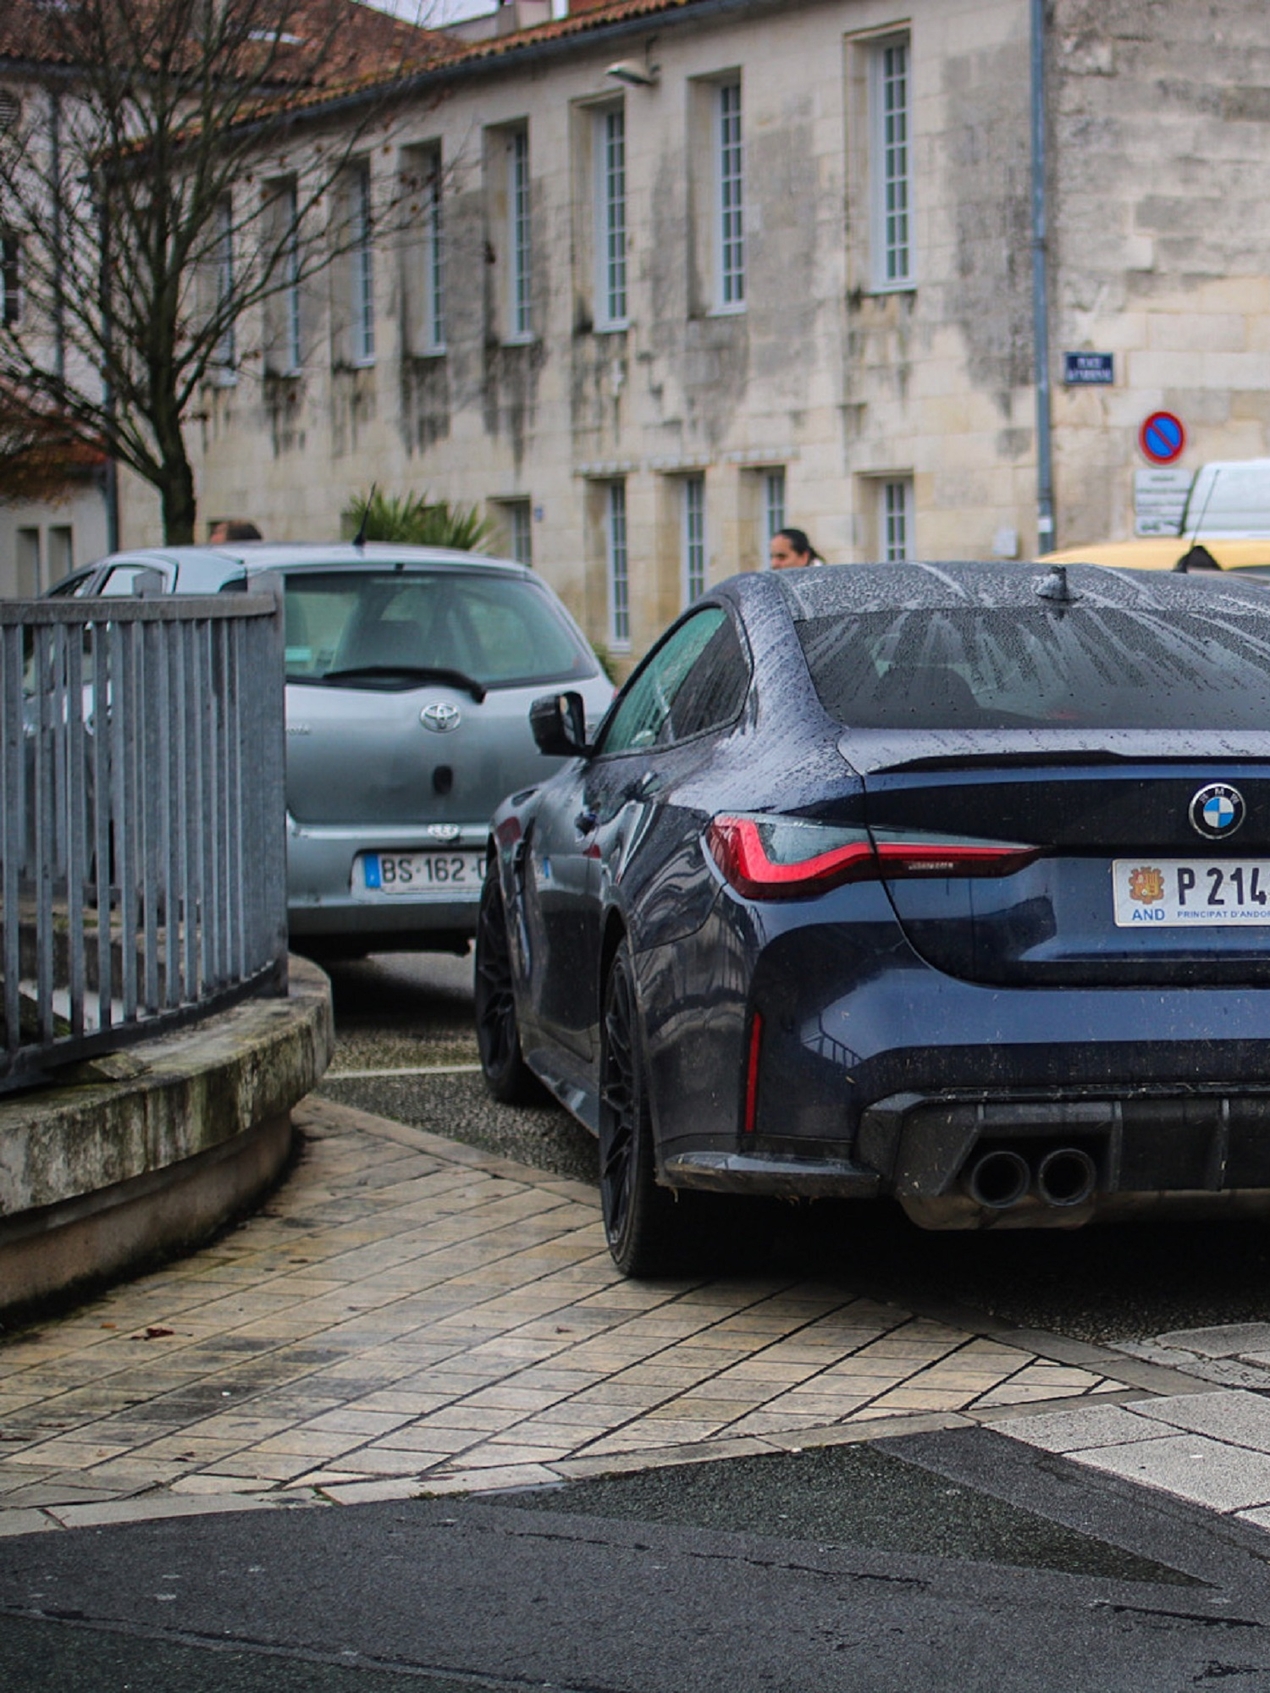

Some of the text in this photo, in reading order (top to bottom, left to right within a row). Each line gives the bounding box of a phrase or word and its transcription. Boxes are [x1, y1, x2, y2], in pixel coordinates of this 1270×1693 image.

[1177, 867, 1196, 906] P
[1131, 908, 1166, 921] AND
[1177, 910, 1227, 919] PRINCIPAT
